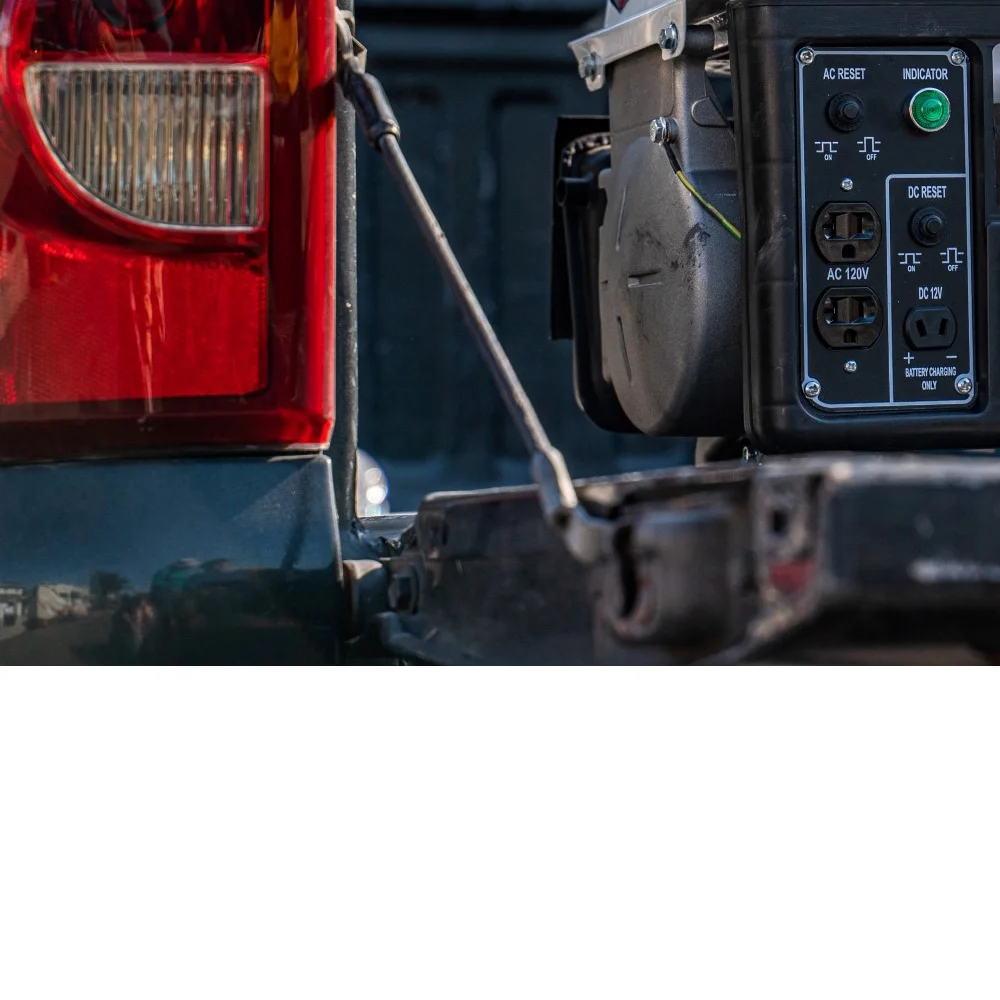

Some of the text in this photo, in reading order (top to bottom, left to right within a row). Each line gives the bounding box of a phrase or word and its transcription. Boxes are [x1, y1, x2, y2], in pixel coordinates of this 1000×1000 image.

[823, 67, 866, 80] AC RESET
[902, 67, 949, 80] INDICATOR
[824, 153, 833, 161] ON
[866, 153, 877, 161] OFF
[908, 185, 947, 198] DC RESET
[826, 267, 870, 281] AC 120V
[947, 264, 959, 272] OFF
[918, 286, 943, 300] DC 12V
[905, 366, 957, 378] BATTERY CHARGING
[921, 380, 938, 391] ONLY
